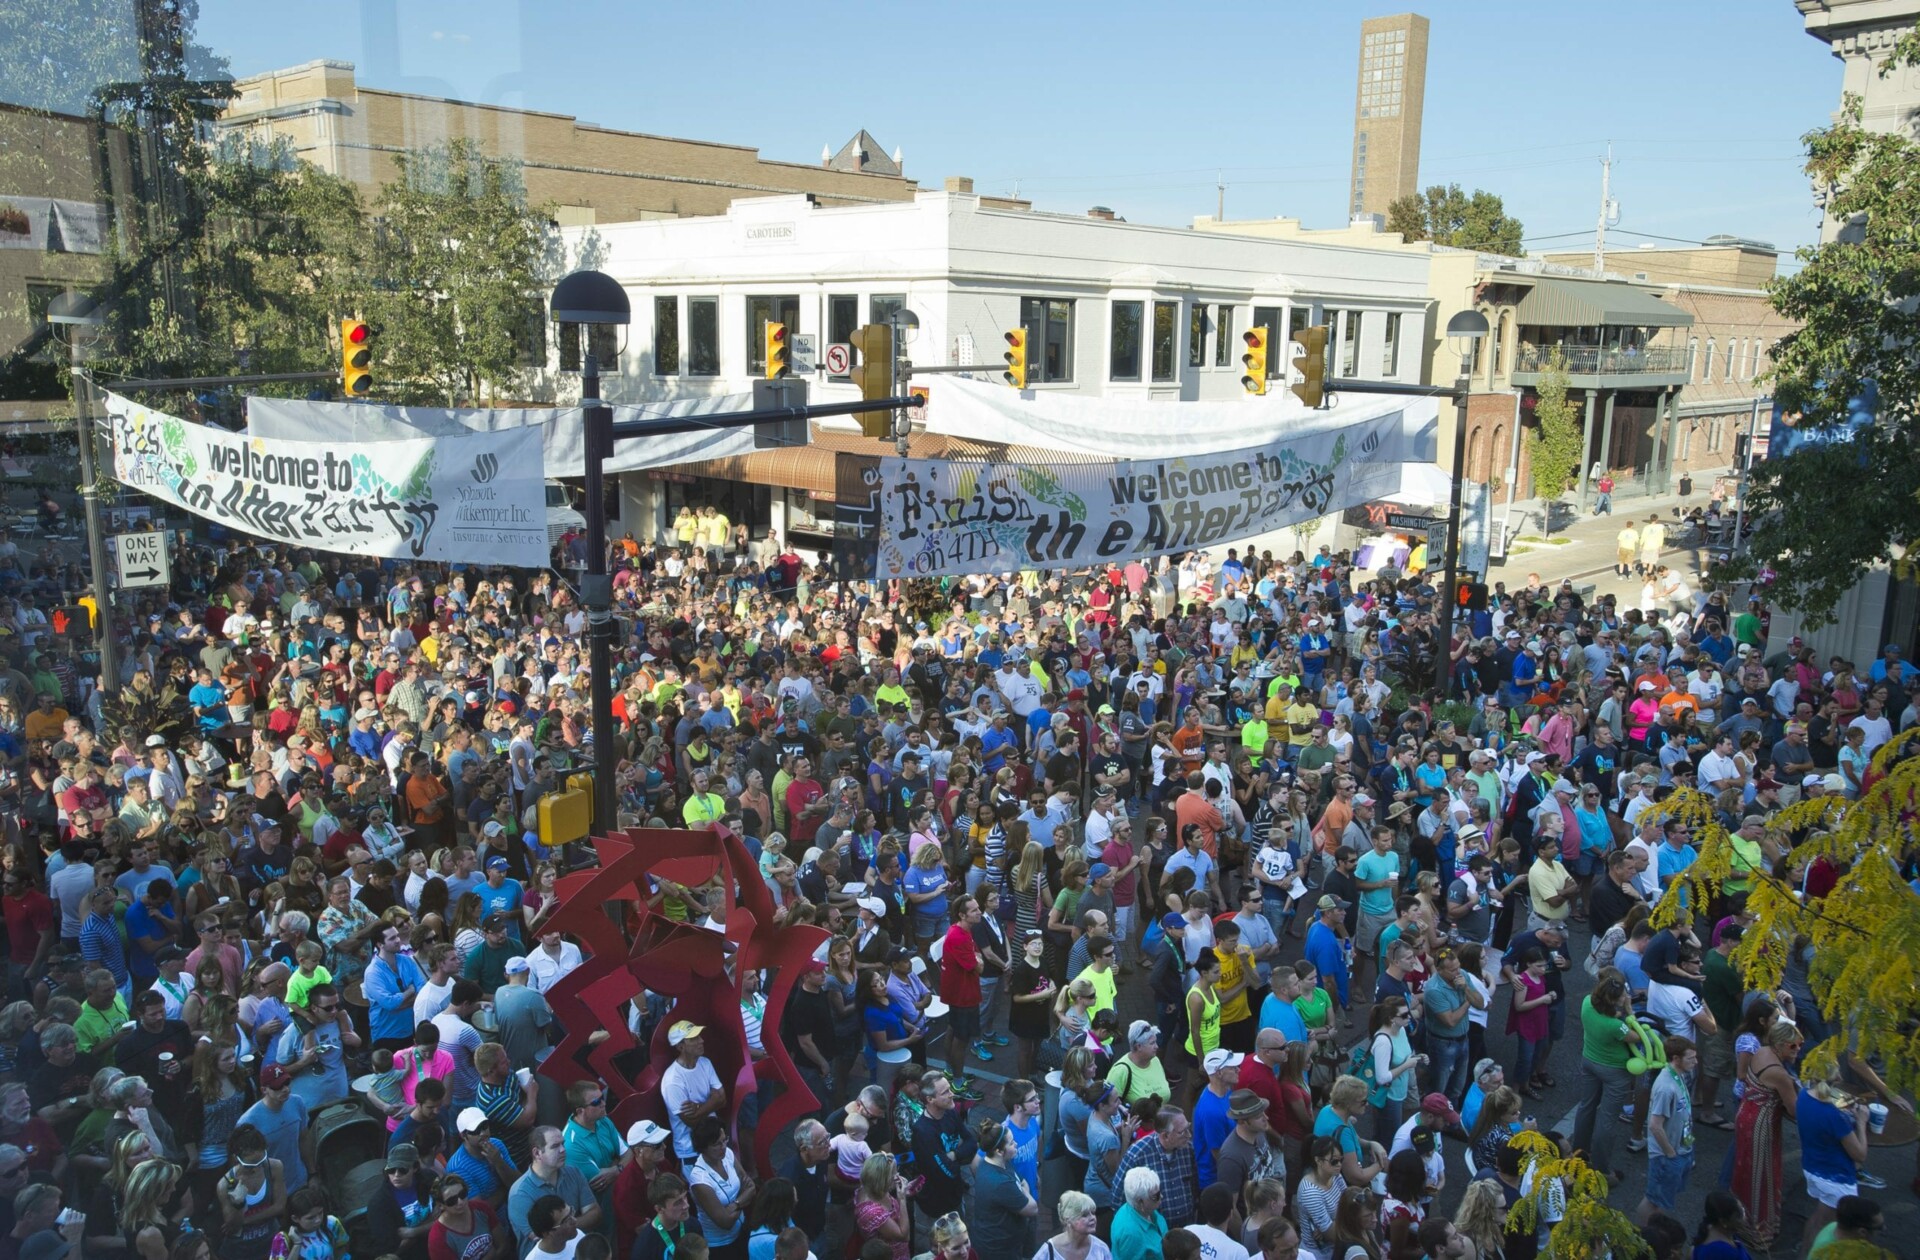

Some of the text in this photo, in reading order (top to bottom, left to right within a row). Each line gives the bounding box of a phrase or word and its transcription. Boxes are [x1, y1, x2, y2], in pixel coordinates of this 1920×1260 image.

[747, 227, 792, 239] CAROTHERS
[797, 338, 809, 346] NO
[1803, 427, 1858, 443] BANK
[207, 441, 352, 492] welcome to
[1108, 451, 1283, 506] welcome to
[1131, 499, 1243, 554] After
[1390, 515, 1431, 529] WASHINGTON
[453, 531, 543, 545] Insurance Services
[1431, 526, 1444, 539] ONE
[125, 536, 157, 550] ONE
[1430, 540, 1443, 551] WAY
[126, 550, 159, 565] WAY
[915, 545, 946, 574] on
[1267, 862, 1280, 877] 12
